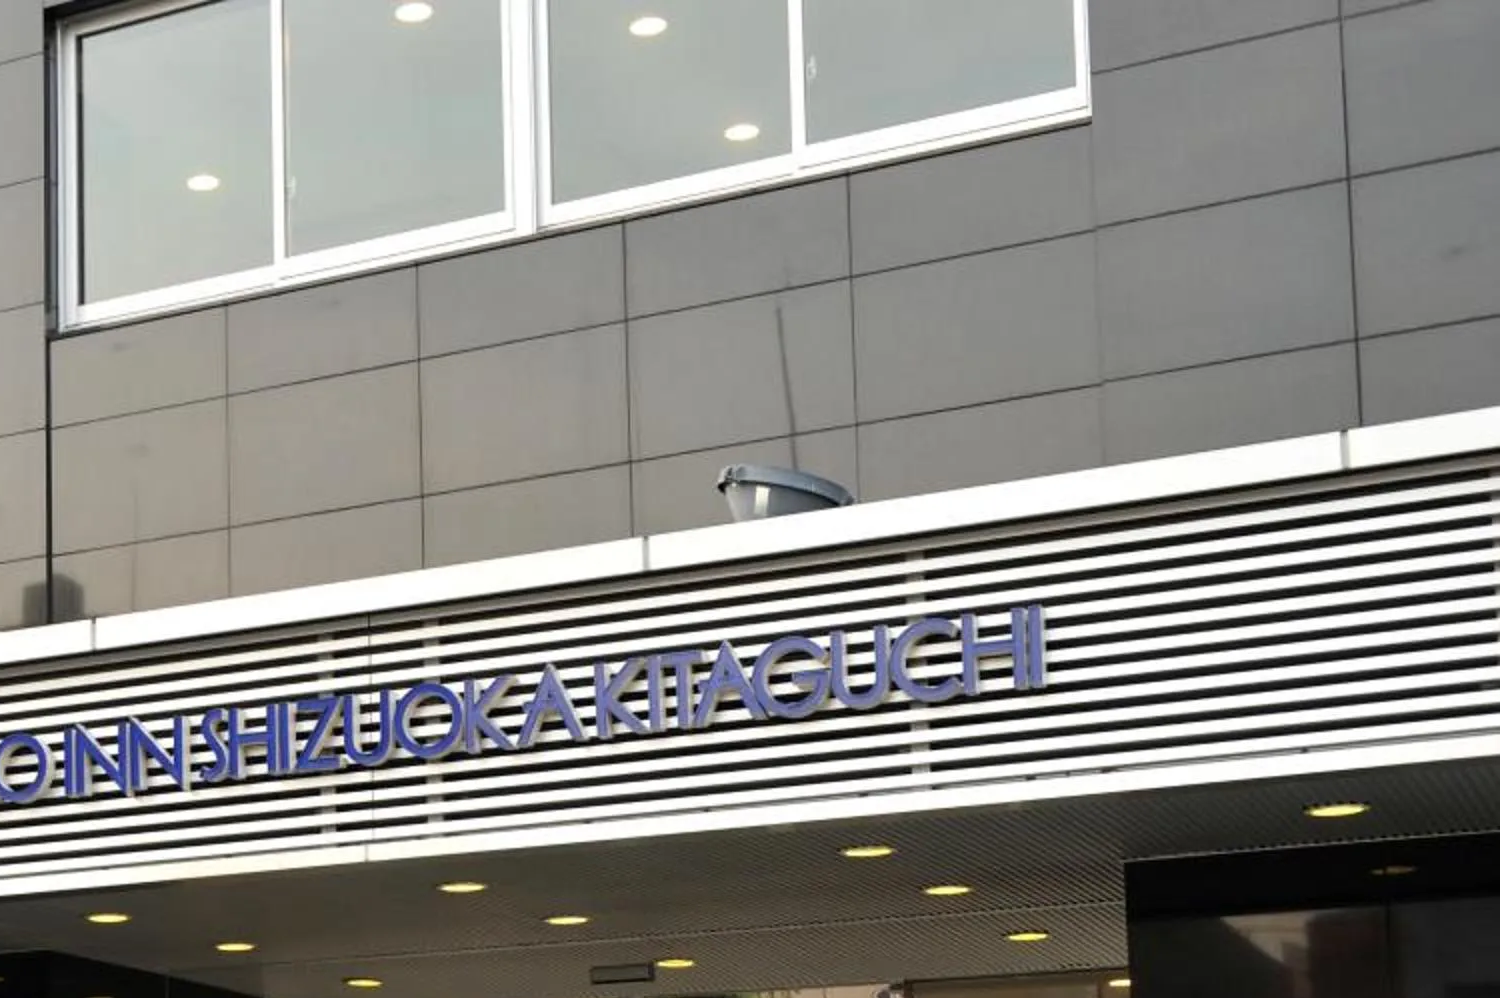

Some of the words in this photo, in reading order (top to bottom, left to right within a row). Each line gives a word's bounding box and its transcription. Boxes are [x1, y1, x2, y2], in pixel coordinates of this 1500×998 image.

[64, 715, 190, 798] INN
[200, 661, 589, 782] SHIZUOKA
[594, 604, 1047, 739] KITAGUCHI
